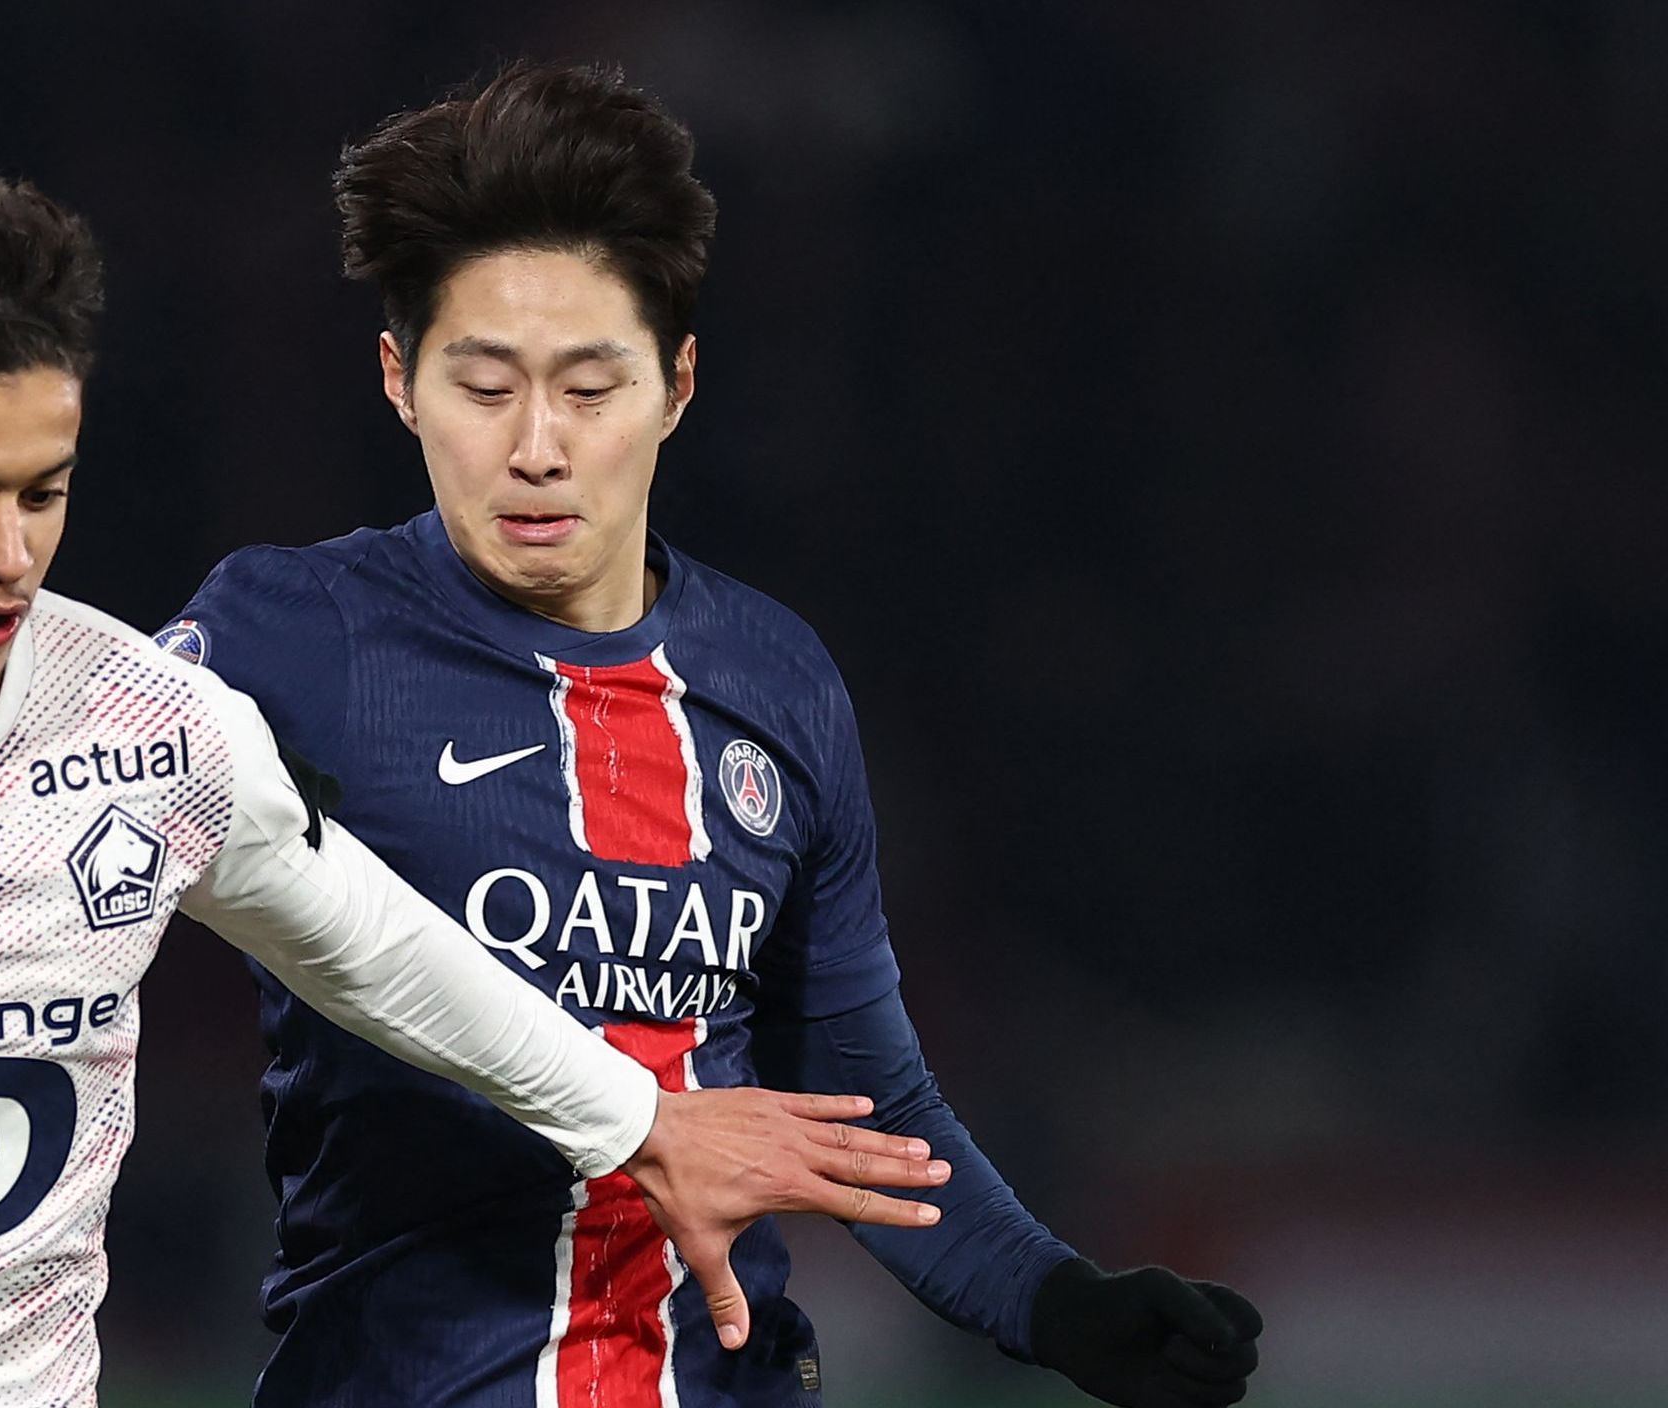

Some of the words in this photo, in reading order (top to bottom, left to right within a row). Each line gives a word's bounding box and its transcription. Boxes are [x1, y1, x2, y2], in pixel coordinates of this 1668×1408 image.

[29, 726, 189, 798] actual
[725, 744, 767, 771] PARIS
[99, 889, 148, 918] LOSC
[464, 867, 766, 970] QATAR
[556, 961, 736, 1018] AIRWAYS
